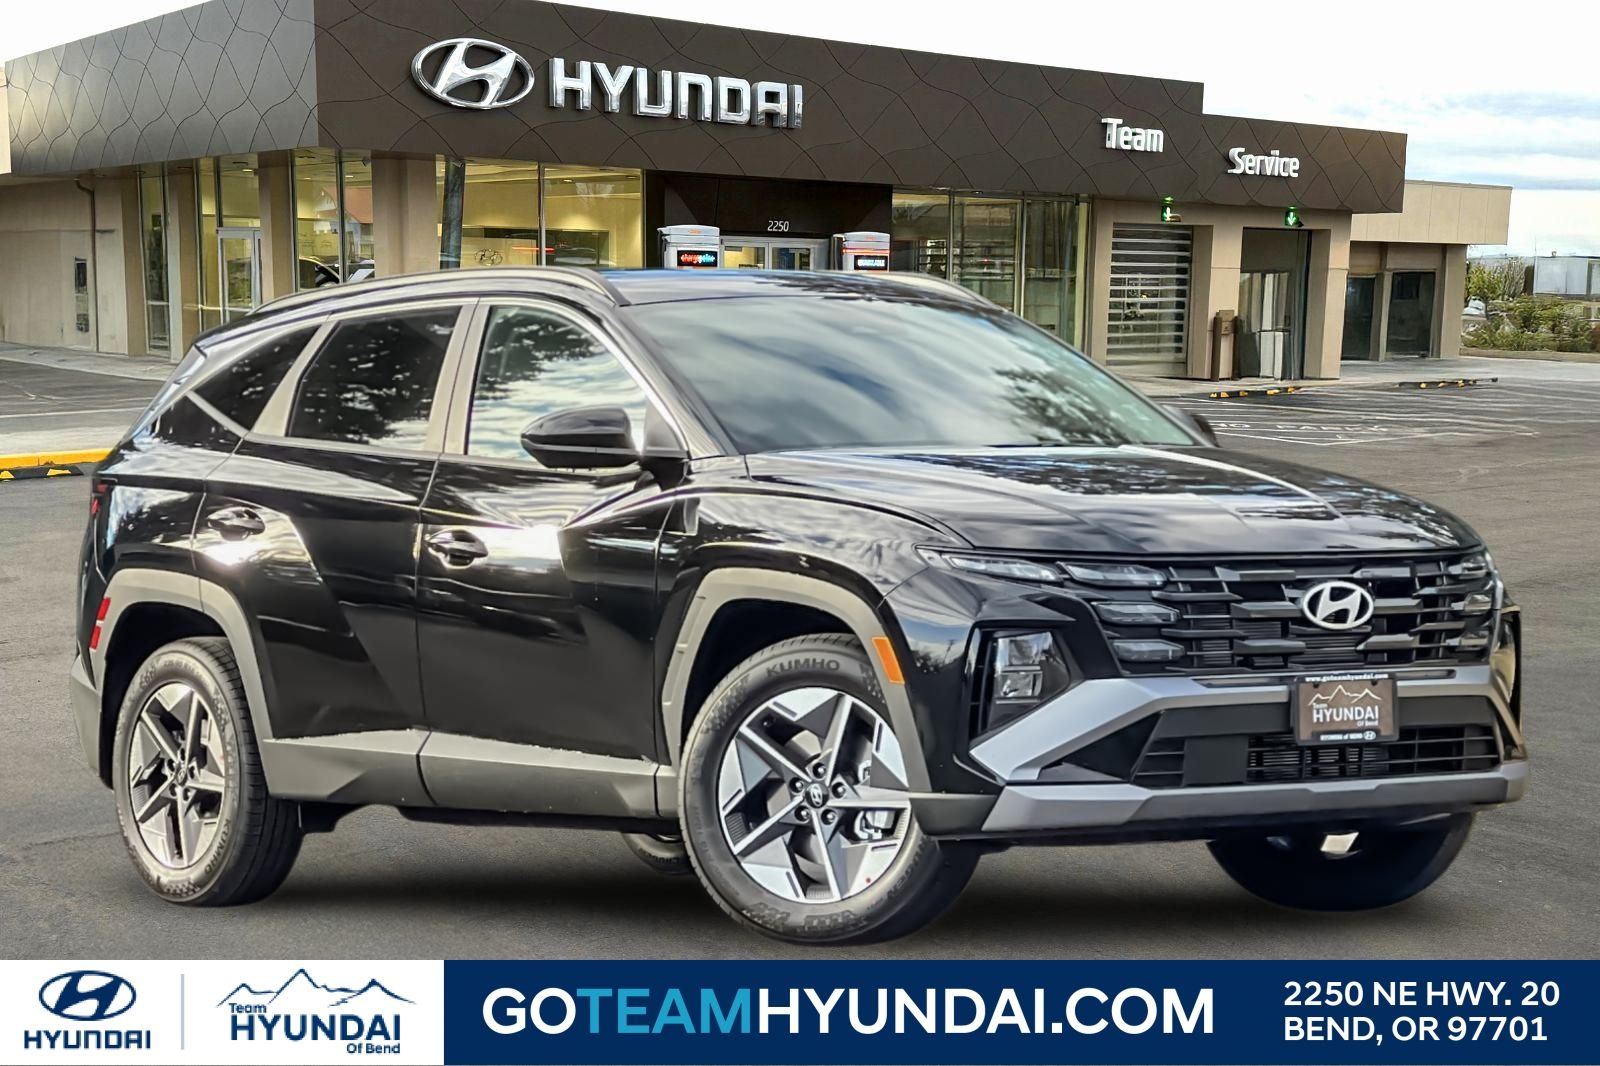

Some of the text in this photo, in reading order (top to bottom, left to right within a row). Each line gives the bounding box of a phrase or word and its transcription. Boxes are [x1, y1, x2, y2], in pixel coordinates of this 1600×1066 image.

[548, 56, 804, 129] HYUNDAI
[1101, 117, 1164, 153] Team
[1227, 147, 1300, 178] Service
[767, 220, 789, 232] 2250
[766, 658, 840, 676] KUMHO
[1312, 705, 1379, 723] HYUNDAI
